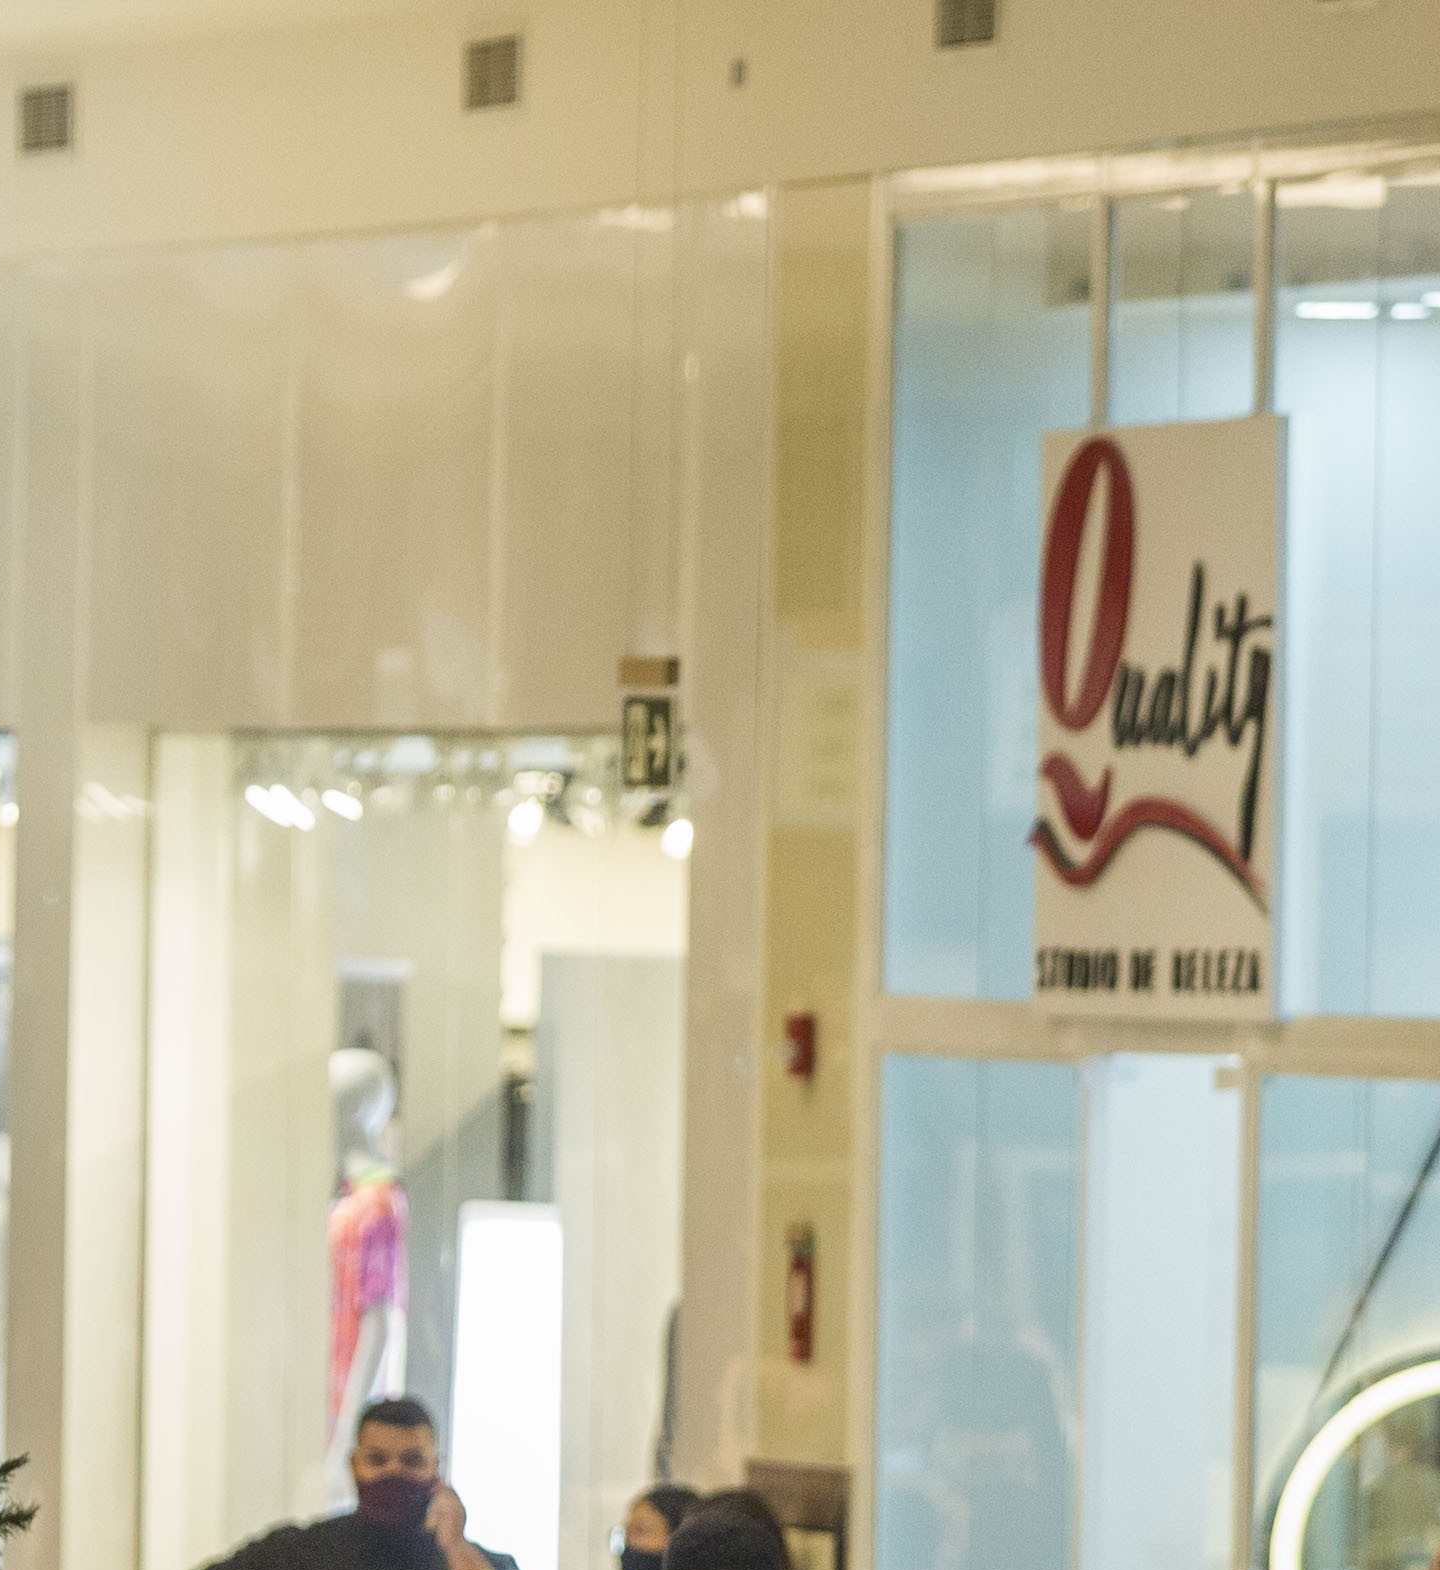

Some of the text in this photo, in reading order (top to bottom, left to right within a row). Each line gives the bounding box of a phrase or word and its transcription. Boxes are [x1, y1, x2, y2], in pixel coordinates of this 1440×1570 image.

[1037, 946, 1261, 994] STUDIO DE BELEZA
